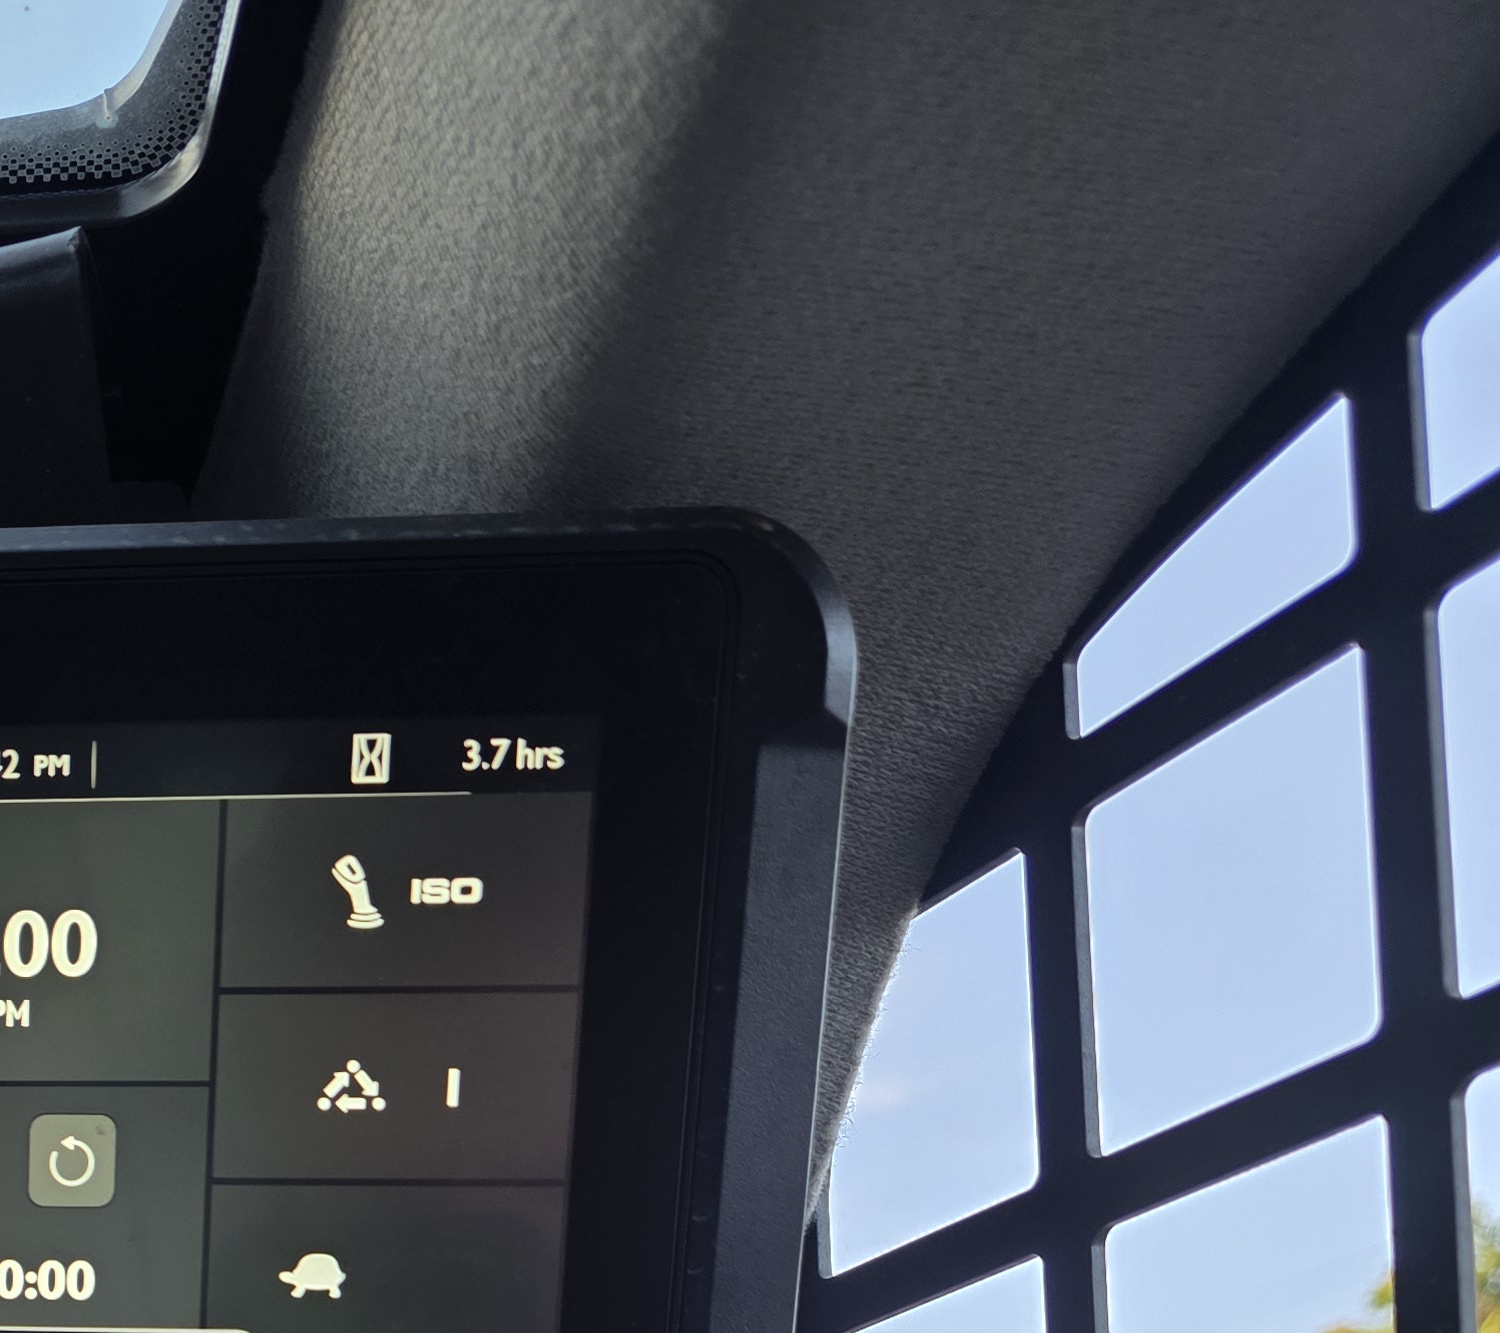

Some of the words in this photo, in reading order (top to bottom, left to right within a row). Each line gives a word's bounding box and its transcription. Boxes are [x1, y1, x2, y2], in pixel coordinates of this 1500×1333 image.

[34, 755, 70, 777] PM
[462, 738, 511, 770] 3.7
[516, 738, 564, 769] hrs
[411, 878, 483, 904] ISO
